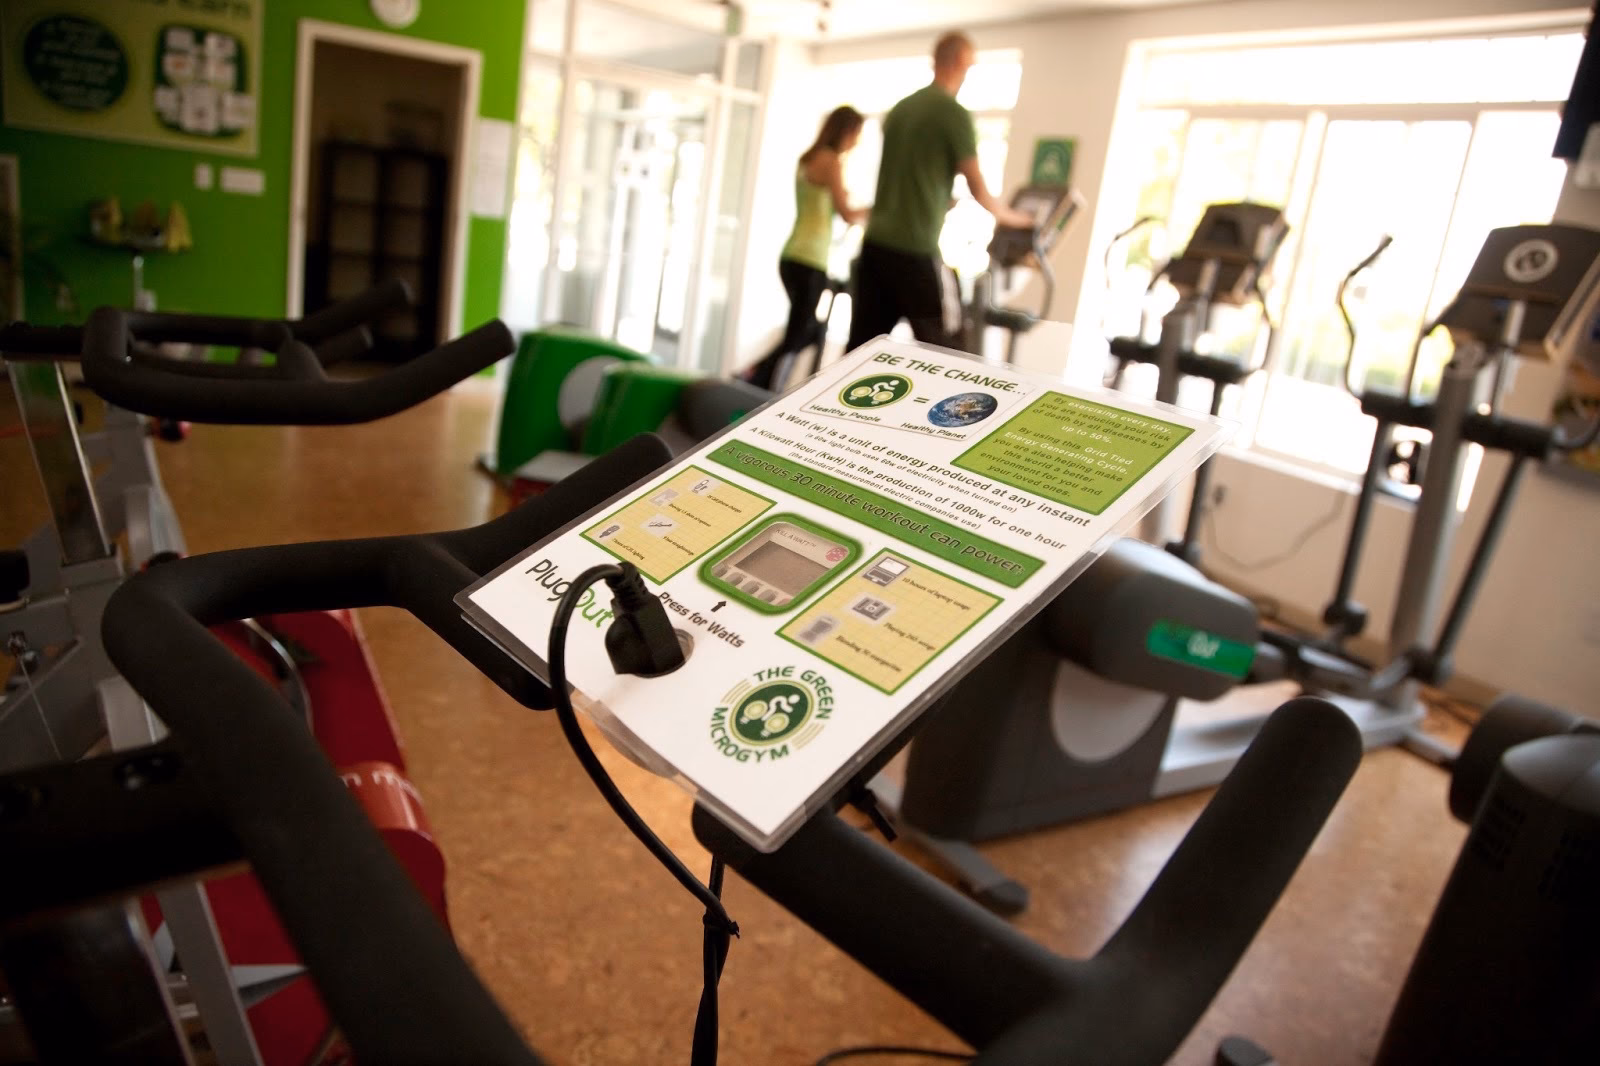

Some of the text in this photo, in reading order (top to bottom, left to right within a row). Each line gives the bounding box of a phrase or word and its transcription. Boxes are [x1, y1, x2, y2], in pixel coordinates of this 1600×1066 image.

[873, 352, 905, 366] BE
[905, 359, 945, 375] THE
[809, 404, 881, 422] Healthy People
[901, 422, 967, 440] Healthy Planet
[1040, 402, 1059, 411] you
[1078, 413, 1122, 429] reducing
[1123, 425, 1149, 435] your
[1149, 432, 1171, 442] risk
[1044, 411, 1071, 423] death
[1073, 419, 1086, 427] by
[1102, 427, 1147, 444] diseases
[1150, 441, 1164, 449] by
[1053, 397, 1067, 405] By
[1068, 401, 1119, 419] exercising
[1120, 416, 1149, 427] every
[1061, 425, 1075, 433] up
[992, 438, 1123, 482] you are also helping make
[1003, 449, 1023, 460] this
[1024, 457, 1054, 469] world
[1062, 469, 1095, 483] better
[1004, 431, 1040, 446] Energy
[1040, 442, 1095, 464] Generating
[1018, 426, 1135, 465] By using this Grid Tied
[758, 429, 794, 446] Kilowatt
[792, 442, 817, 454] Hour
[815, 451, 847, 465] (KwH)
[846, 461, 857, 469] is
[857, 465, 875, 476] the
[873, 473, 934, 499] production
[934, 495, 950, 504] of
[950, 501, 986, 519] 1000w
[987, 515, 1008, 528] for
[1008, 524, 1033, 538] one
[1034, 533, 1068, 550] hour
[775, 411, 786, 419] A
[786, 414, 810, 427] Watt
[807, 422, 828, 433] (w)
[827, 428, 838, 437] is
[848, 437, 873, 448] unit
[871, 445, 888, 453] of
[886, 450, 929, 468] energy
[926, 464, 992, 491] produced
[991, 486, 1009, 498] at
[1008, 493, 1036, 509] any
[1036, 502, 1092, 527] instant
[828, 440, 845, 449] light
[861, 453, 880, 461] uses
[880, 458, 896, 467] 60w
[906, 468, 947, 487] electricity
[947, 483, 970, 495] when
[971, 492, 1002, 507] turned
[1001, 504, 1018, 513] on)
[980, 452, 1103, 496] environment for you and
[986, 465, 1070, 497] your loved ones.
[724, 446, 736, 455] A
[735, 452, 791, 479] vigorous
[789, 472, 814, 486] 30
[812, 481, 861, 506] minute
[860, 501, 931, 535] workout
[929, 530, 962, 549] can
[803, 456, 835, 471] standard
[834, 468, 884, 490] measurement
[883, 487, 914, 502] electric
[914, 499, 960, 521] companies
[960, 519, 982, 530] use)
[525, 558, 571, 602] Plug
[658, 591, 745, 648] Press for Watts
[753, 665, 834, 720] THE GREEN
[710, 706, 790, 763] MICROGYM
